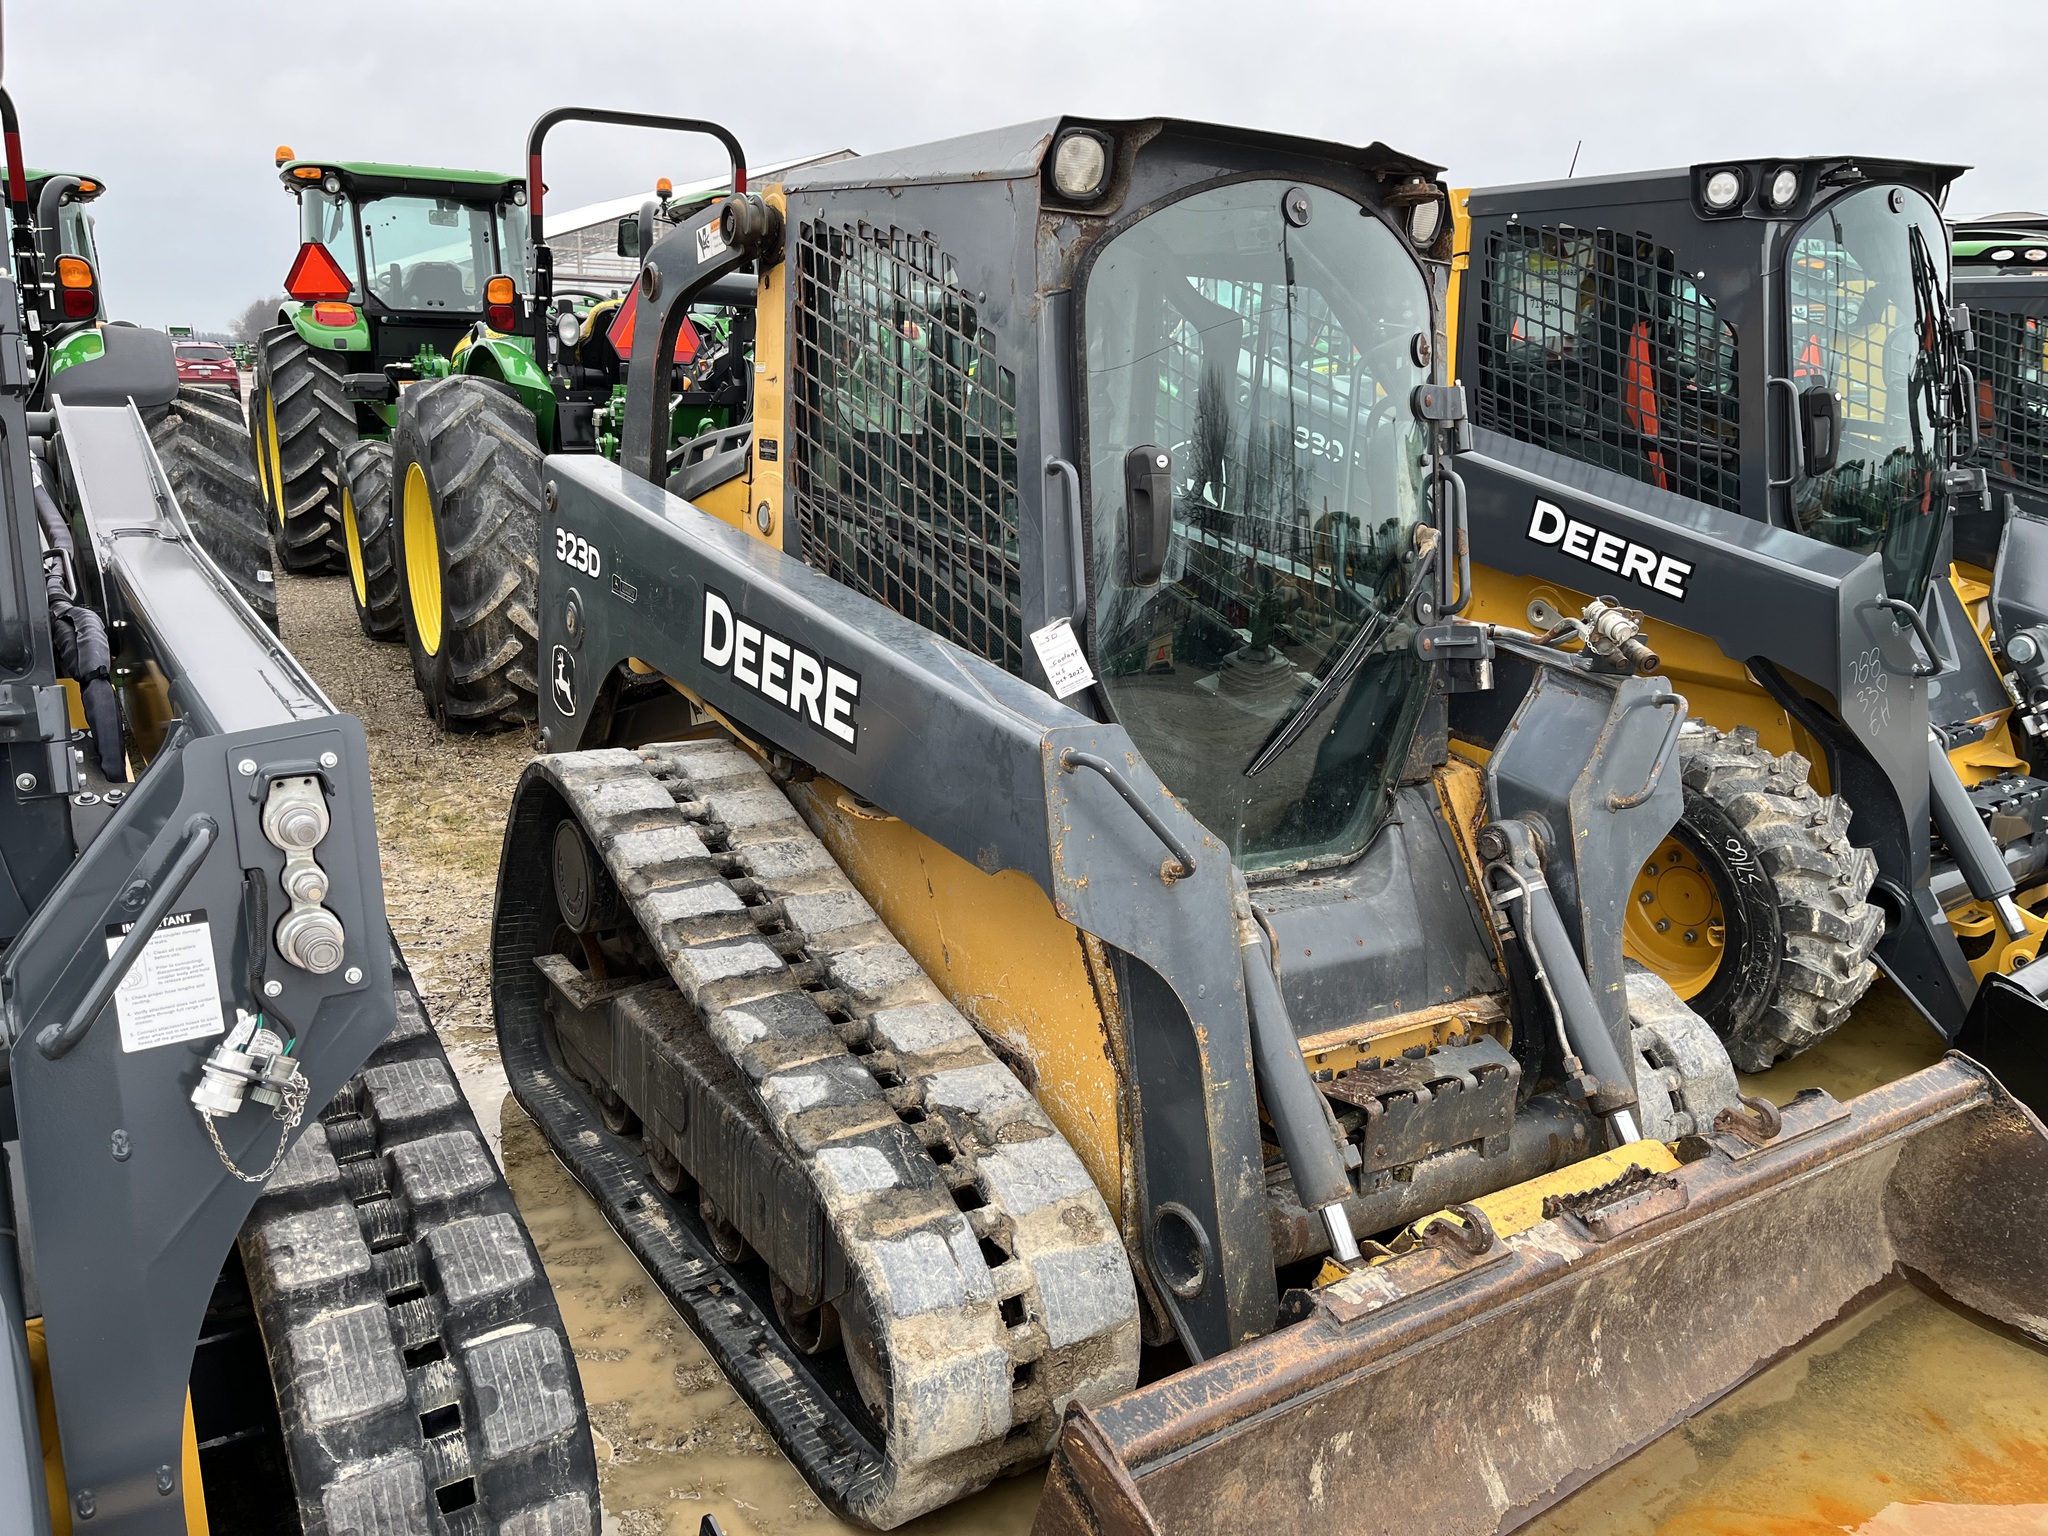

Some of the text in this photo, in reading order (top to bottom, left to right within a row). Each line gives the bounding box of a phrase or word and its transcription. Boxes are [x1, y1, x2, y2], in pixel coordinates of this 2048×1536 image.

[556, 527, 600, 578] 323D
[1528, 500, 1691, 599] DEERE
[704, 592, 858, 744] DEERE
[1068, 666, 1085, 679] 2023
[1856, 673, 1888, 713] 330
[122, 914, 192, 934] IMTANT
